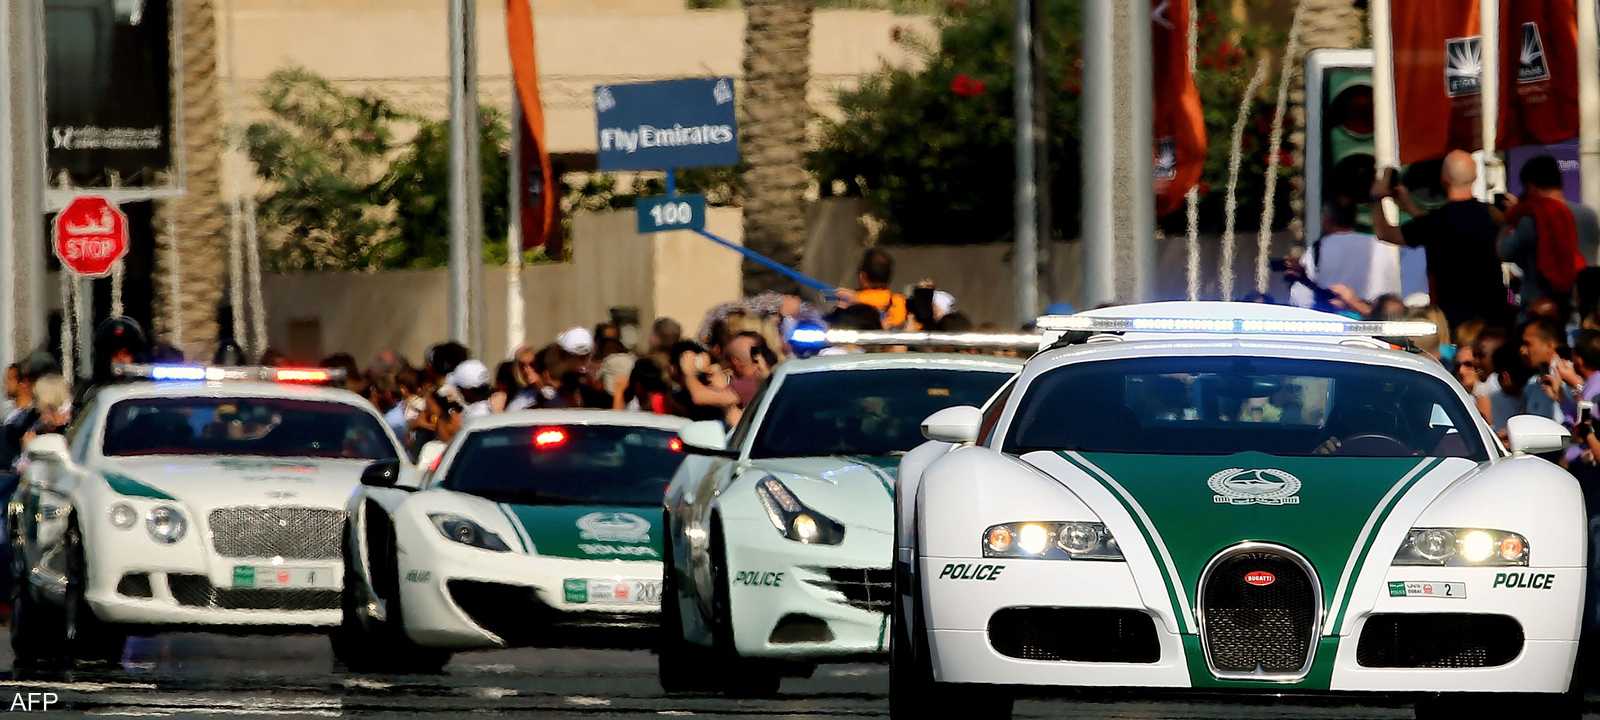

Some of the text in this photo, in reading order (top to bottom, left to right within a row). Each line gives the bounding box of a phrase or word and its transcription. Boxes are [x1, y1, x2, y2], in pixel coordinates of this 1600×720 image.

[601, 123, 733, 153] Fly Emirates
[649, 202, 692, 226] 100
[65, 237, 116, 260] STOP
[733, 571, 784, 587] POLICE
[939, 564, 1005, 580] POLICE
[1493, 573, 1556, 589] POLICE
[1445, 584, 1452, 596] 2
